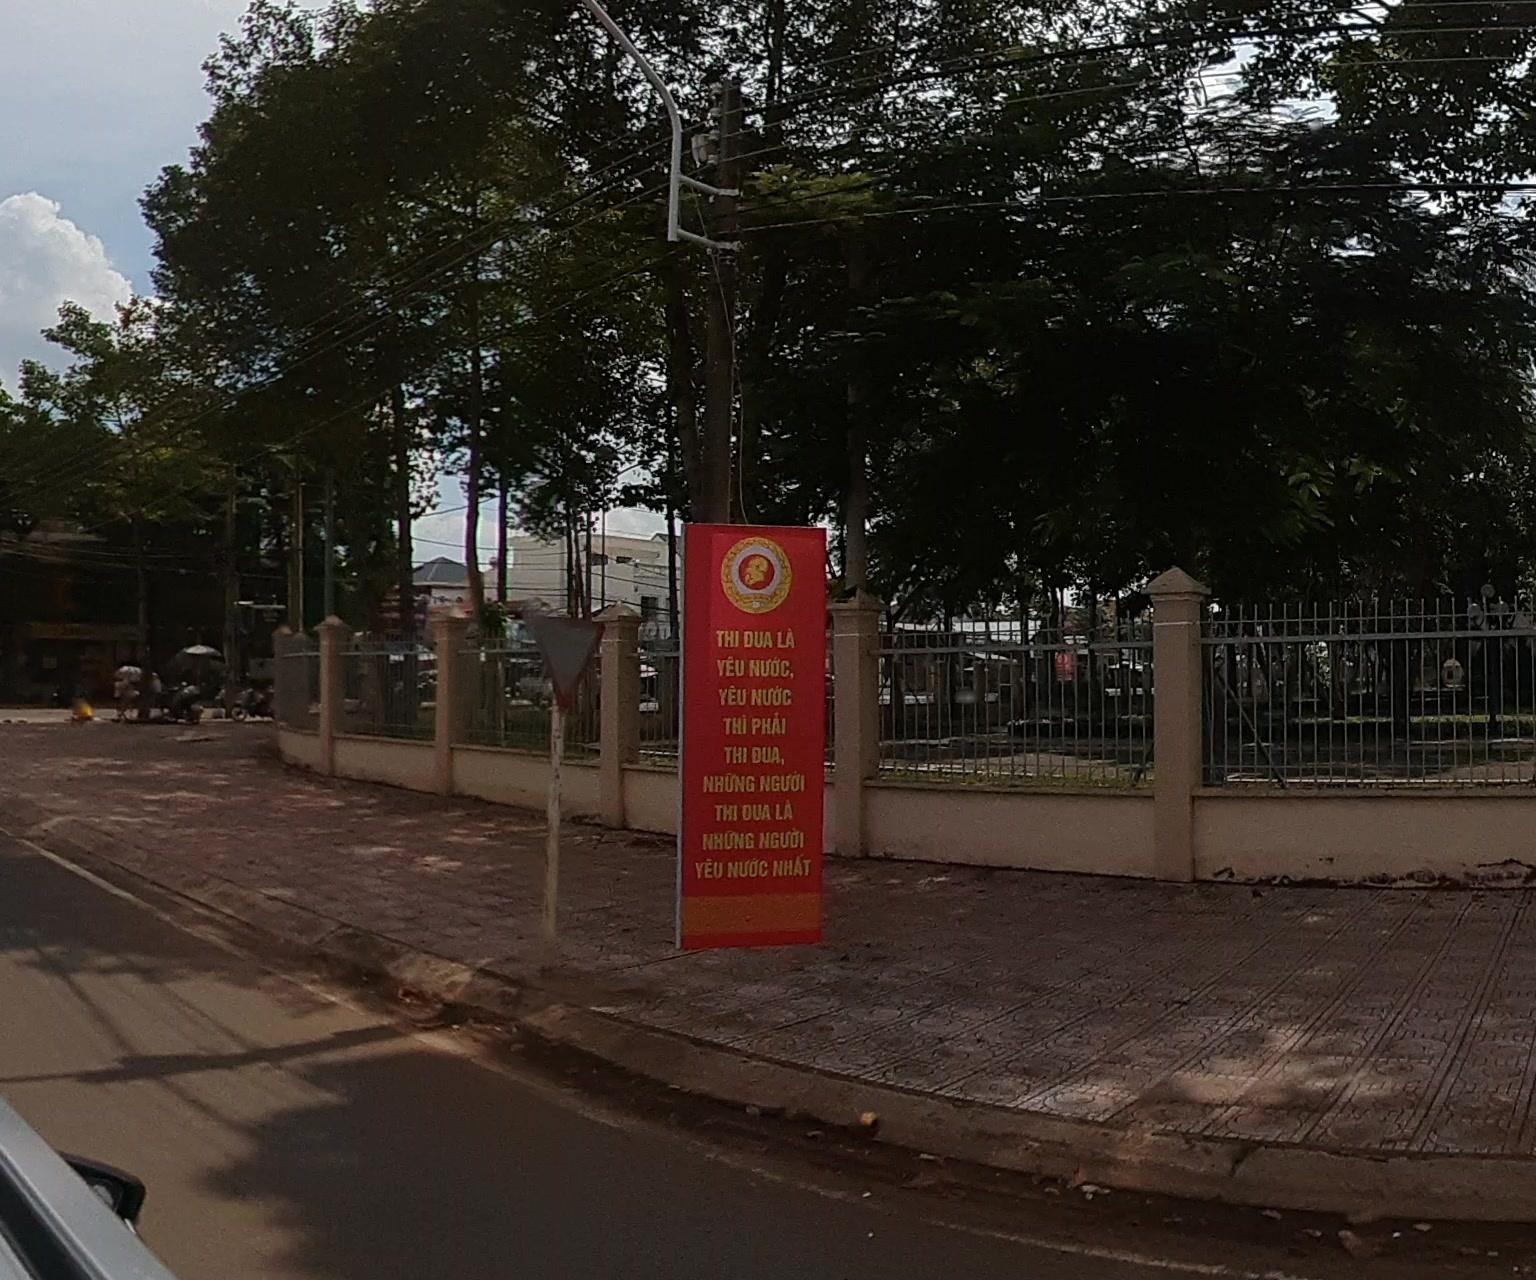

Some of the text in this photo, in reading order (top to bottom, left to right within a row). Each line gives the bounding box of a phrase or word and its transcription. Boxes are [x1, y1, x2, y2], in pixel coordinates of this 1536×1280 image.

[716, 627, 795, 648] THI ĐUA LÀ
[717, 656, 794, 679] YÊU NƯỚC,
[719, 685, 792, 706] YÊU NƯỚC
[723, 712, 786, 735] THÌ PHẢI
[724, 746, 785, 765] THI ĐUA,
[703, 770, 805, 793] NHỮNG NGƯỜI
[715, 804, 738, 821] THI
[775, 799, 793, 820] LÀ
[702, 827, 804, 850] NHỮNG NGƯỜI
[696, 853, 812, 879] YÊU NƯỚC NHẤT
